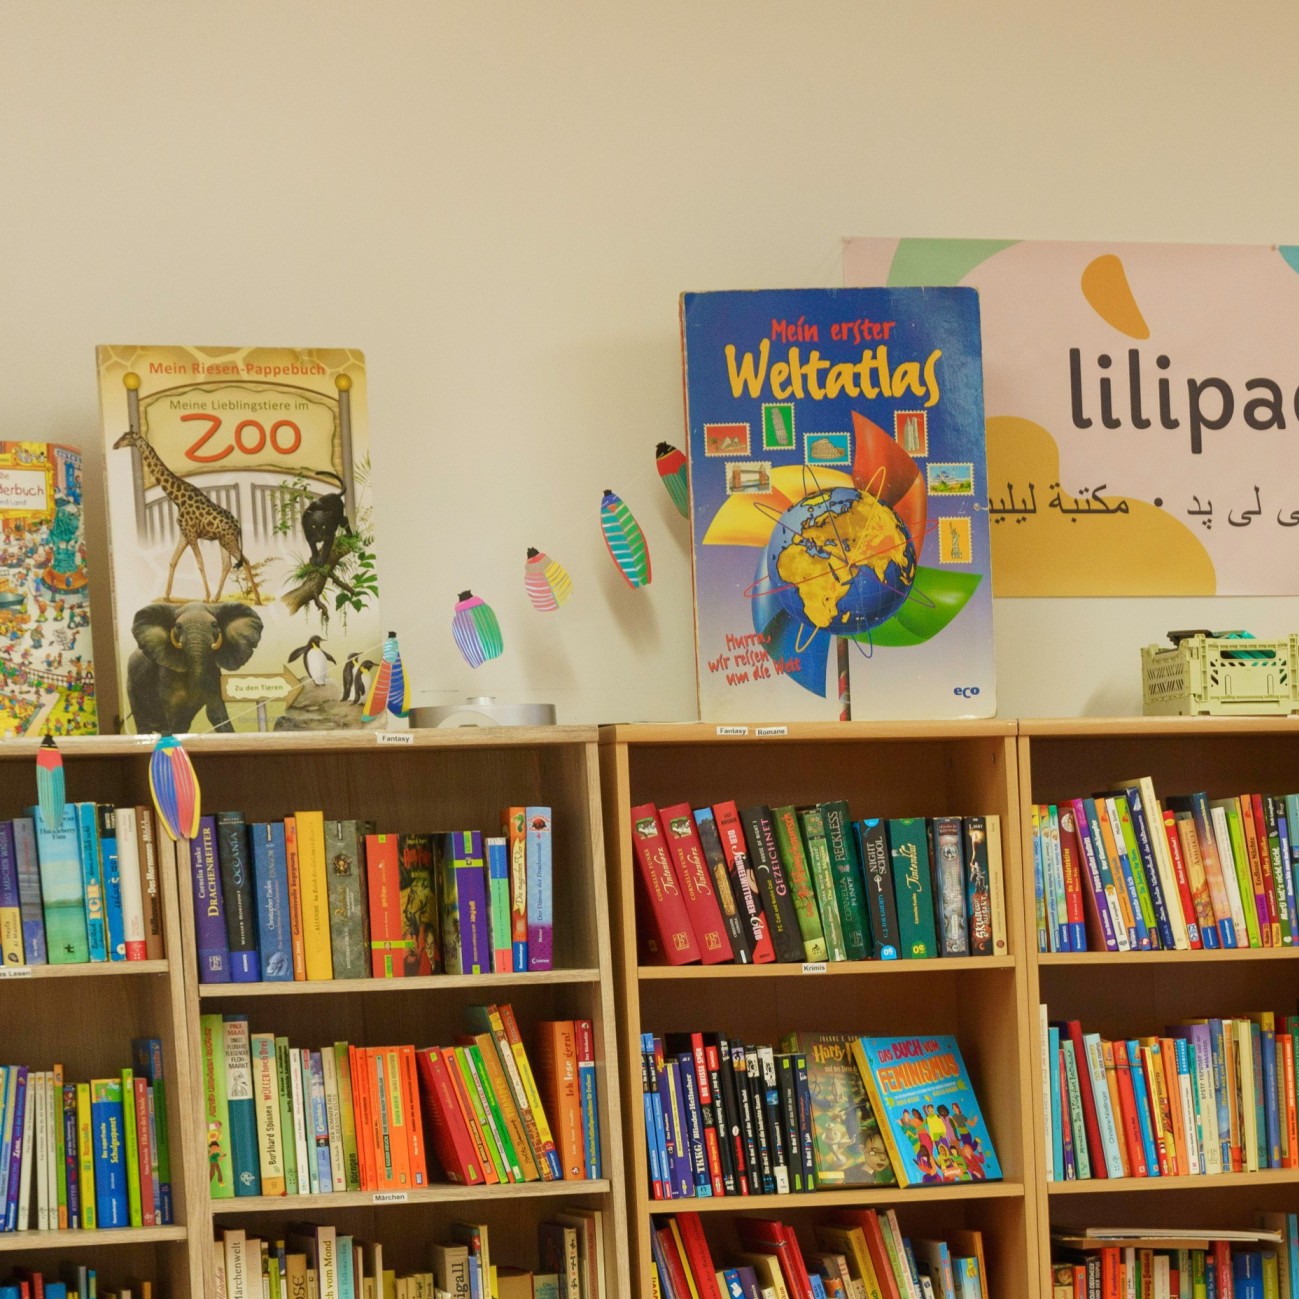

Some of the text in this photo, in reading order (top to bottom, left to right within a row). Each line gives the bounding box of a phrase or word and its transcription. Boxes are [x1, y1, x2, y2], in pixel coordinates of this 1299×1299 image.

[771, 316, 896, 344] Mein erster
[148, 360, 326, 379] Mein Riesen-Pappebuch
[724, 339, 941, 406] Weltatlas
[169, 398, 309, 413] Meine Lieblingstiere im
[726, 635, 771, 653] Hurra,
[709, 649, 769, 672] wir reisen
[727, 658, 801, 686] um die Welt
[234, 683, 283, 692] Zu den Tieren
[953, 685, 979, 698] eco
[382, 735, 409, 743] Fantasy
[719, 727, 785, 736] Fantasy Romane
[828, 811, 846, 861] RECKLESS
[761, 818, 787, 896] GEZEICHNET
[866, 842, 878, 872] NIGHT
[876, 836, 887, 874] SCHOOL
[1249, 837, 1262, 886] Endlose Nächte
[195, 847, 206, 898] Cornelia Funke
[203, 828, 219, 916] DRACHENREITER
[643, 848, 663, 901] CORNELIA FUNKE
[654, 847, 679, 896] Tintenherz
[677, 848, 696, 900] CORNELIA FUNKE
[687, 847, 711, 896] Tintenherz
[840, 876, 858, 921] CORNELIA FUNKE
[562, 1032, 575, 1096] Ich lese gern!
[812, 1044, 844, 1065] Harry
[892, 1039, 925, 1059] BUCH
[876, 1052, 960, 1094] FEMINISMUS
[109, 1116, 120, 1163] Schulgespenst
[265, 1105, 276, 1165] Burkhard Spinnen
[348, 1153, 359, 1183] Börngen
[375, 1194, 405, 1202] Märchen
[322, 1240, 333, 1267] Mond
[326, 1269, 335, 1289] vom
